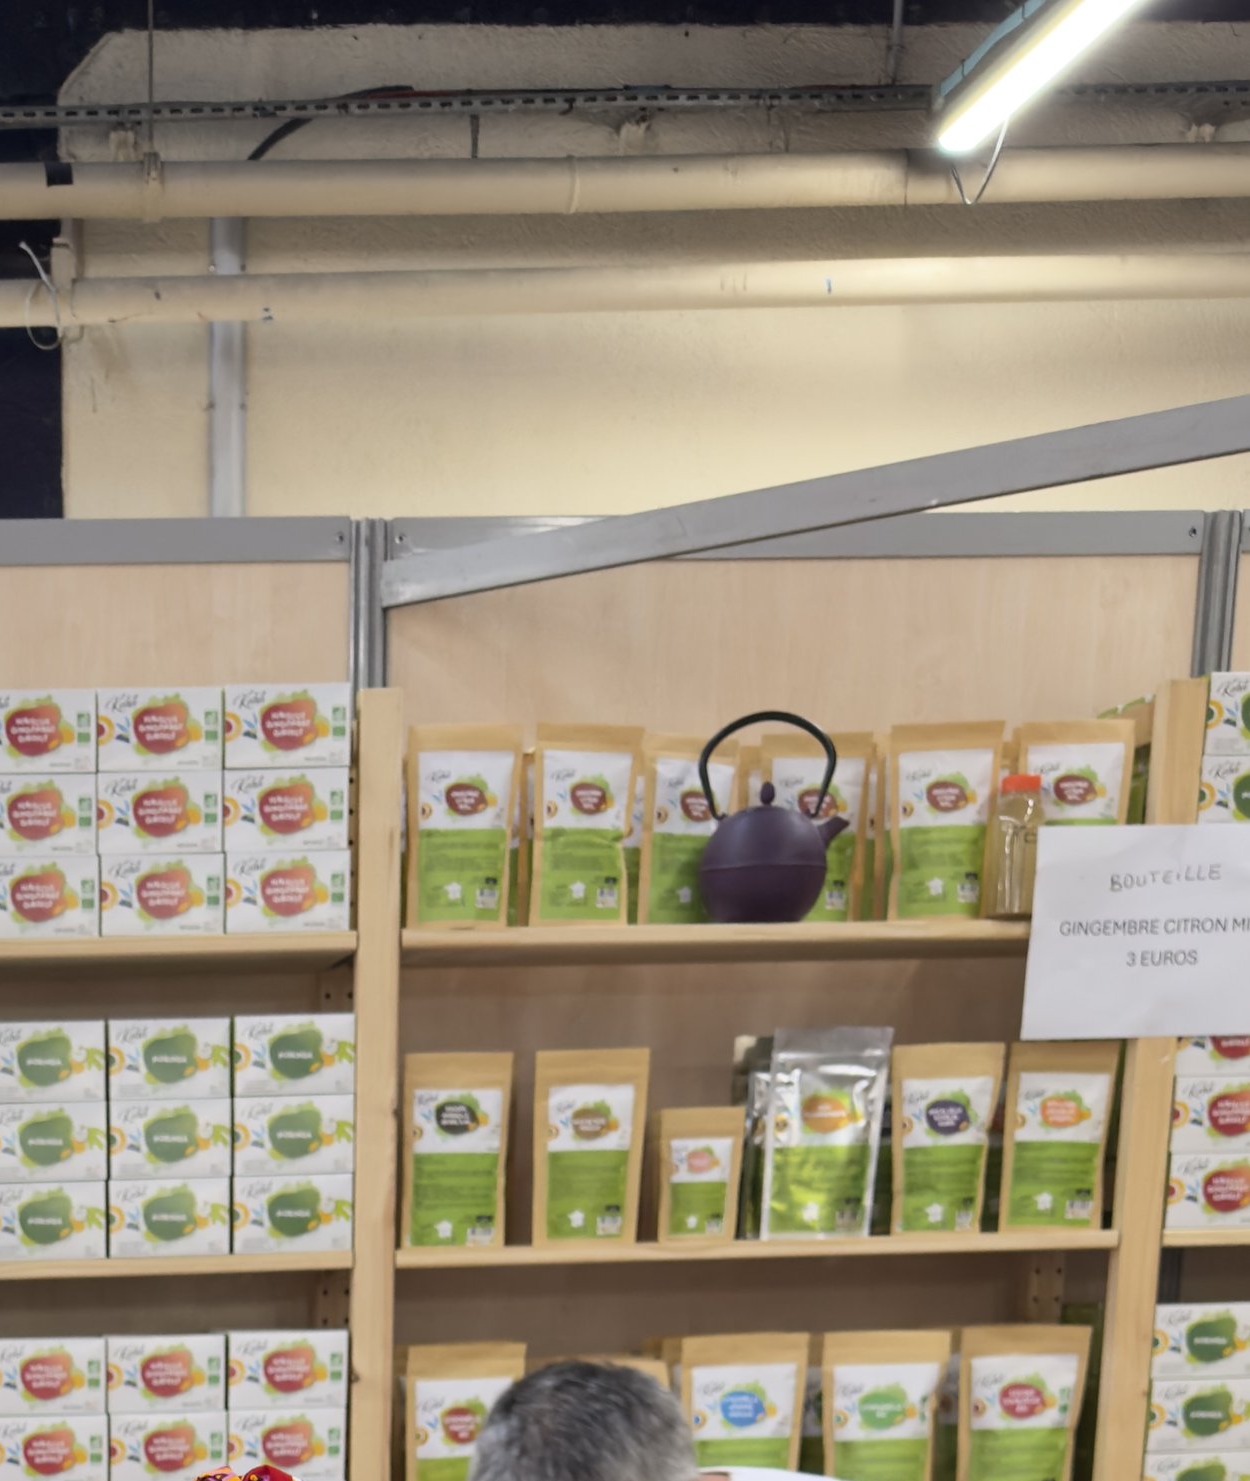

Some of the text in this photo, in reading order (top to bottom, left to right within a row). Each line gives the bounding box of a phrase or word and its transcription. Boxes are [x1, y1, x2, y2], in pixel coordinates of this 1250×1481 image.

[1059, 919, 1159, 937] GINGEMBRE
[1163, 918, 1228, 935] CITRON
[1126, 950, 1198, 967] 3 EUROS
